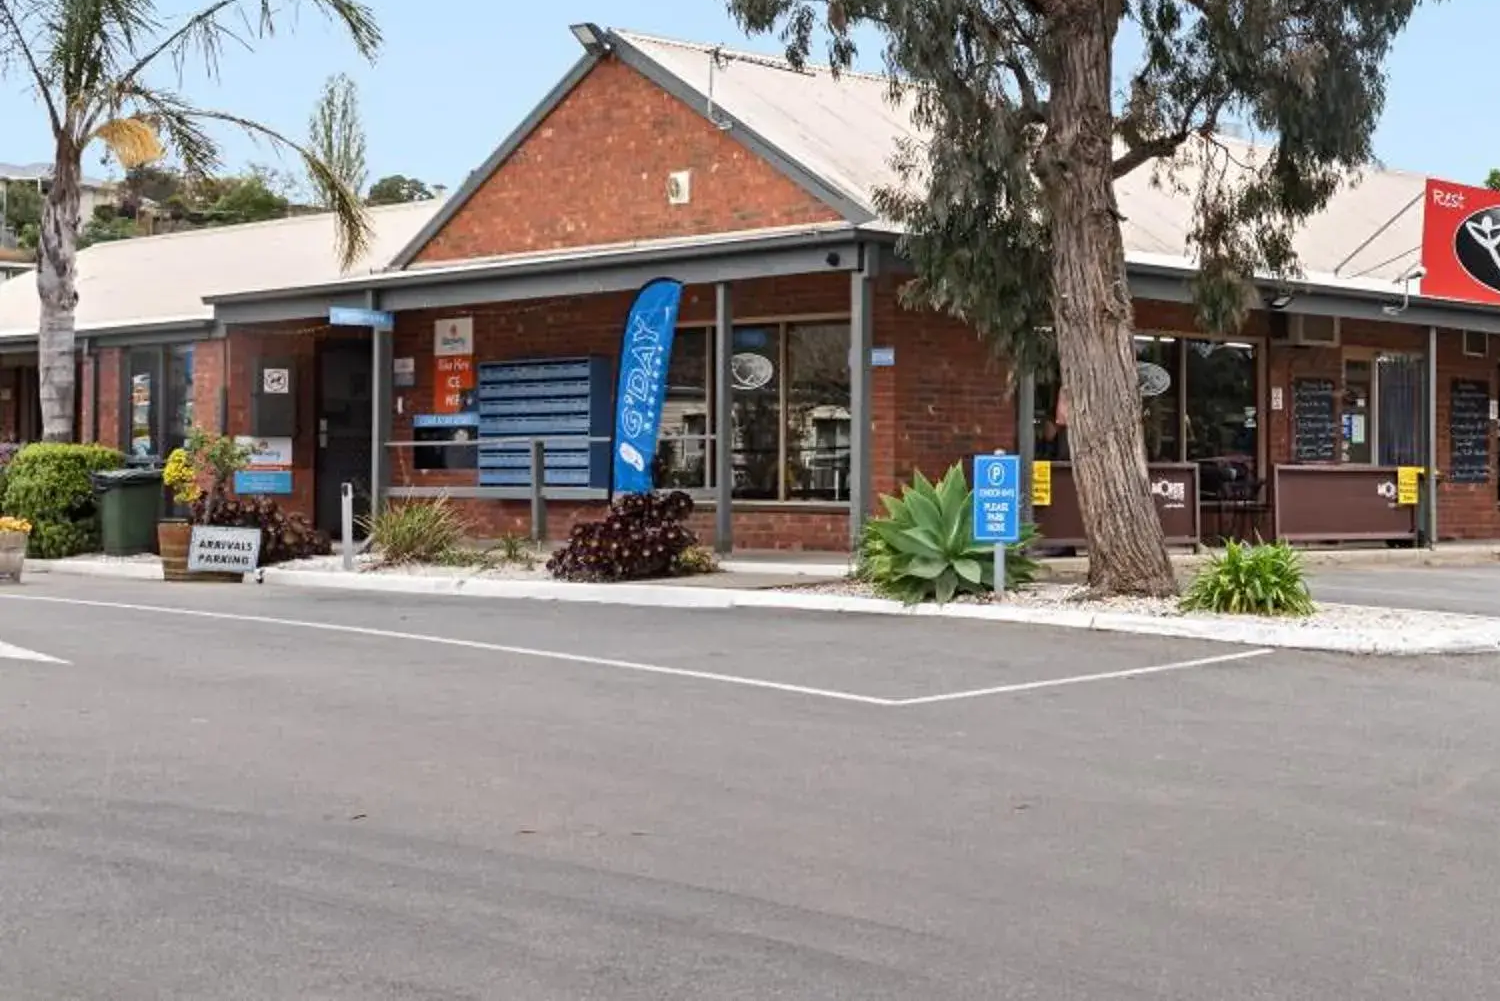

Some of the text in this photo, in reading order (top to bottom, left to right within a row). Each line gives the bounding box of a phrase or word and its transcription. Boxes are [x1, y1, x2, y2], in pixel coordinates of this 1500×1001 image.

[1432, 189, 1465, 209] Rest
[199, 539, 253, 551] ARRIVALS
[198, 554, 249, 565] PARKING
